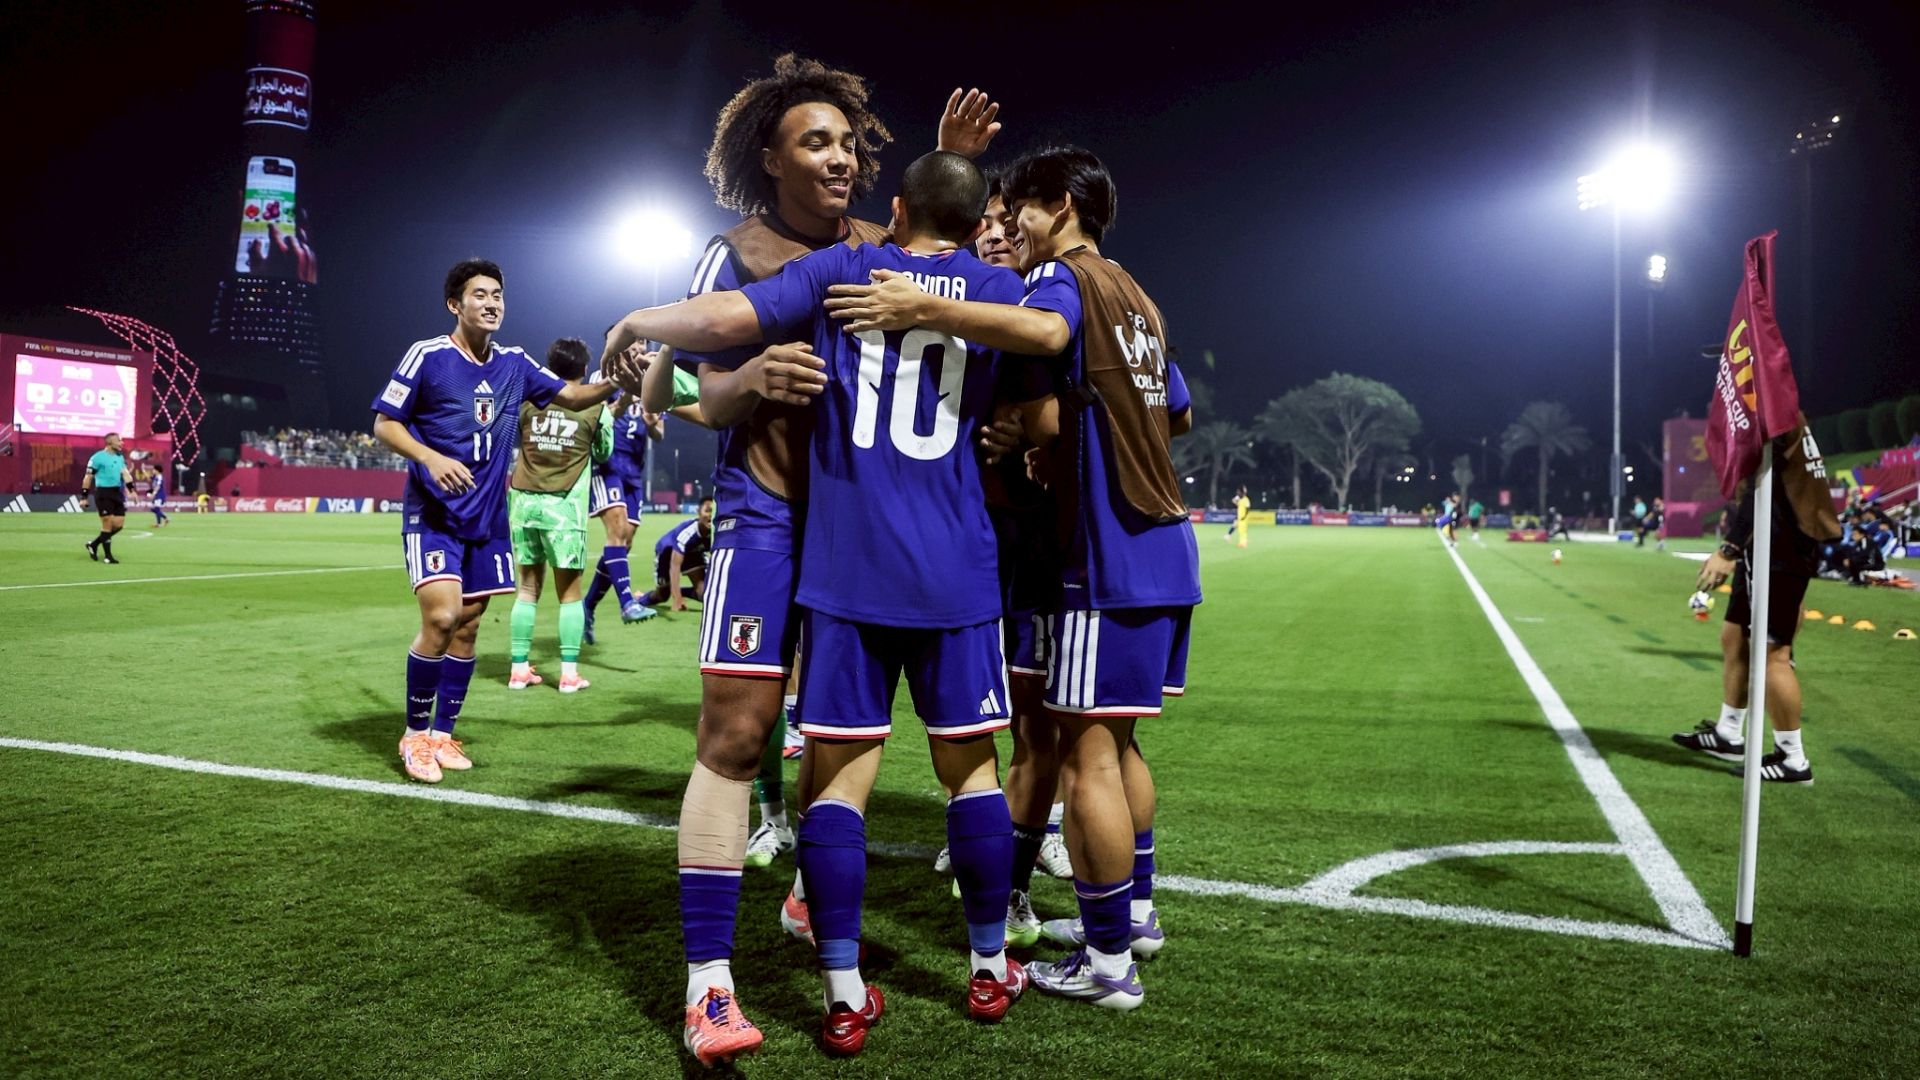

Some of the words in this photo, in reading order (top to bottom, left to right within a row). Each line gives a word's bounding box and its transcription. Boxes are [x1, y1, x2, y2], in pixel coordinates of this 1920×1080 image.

[25, 342, 40, 351] FIFA
[57, 386, 71, 405] 2
[80, 388, 95, 407] 0
[852, 318, 967, 461] 10
[547, 410, 565, 419] FIFA
[1731, 400, 1750, 430] CUP
[531, 415, 579, 438] U17
[626, 420, 638, 440] 2
[473, 431, 493, 462] 11
[530, 435, 558, 444] WORLD
[558, 437, 575, 446] CUP
[537, 442, 562, 452] QATAR
[326, 498, 356, 512] VISA
[494, 551, 514, 584] 11
